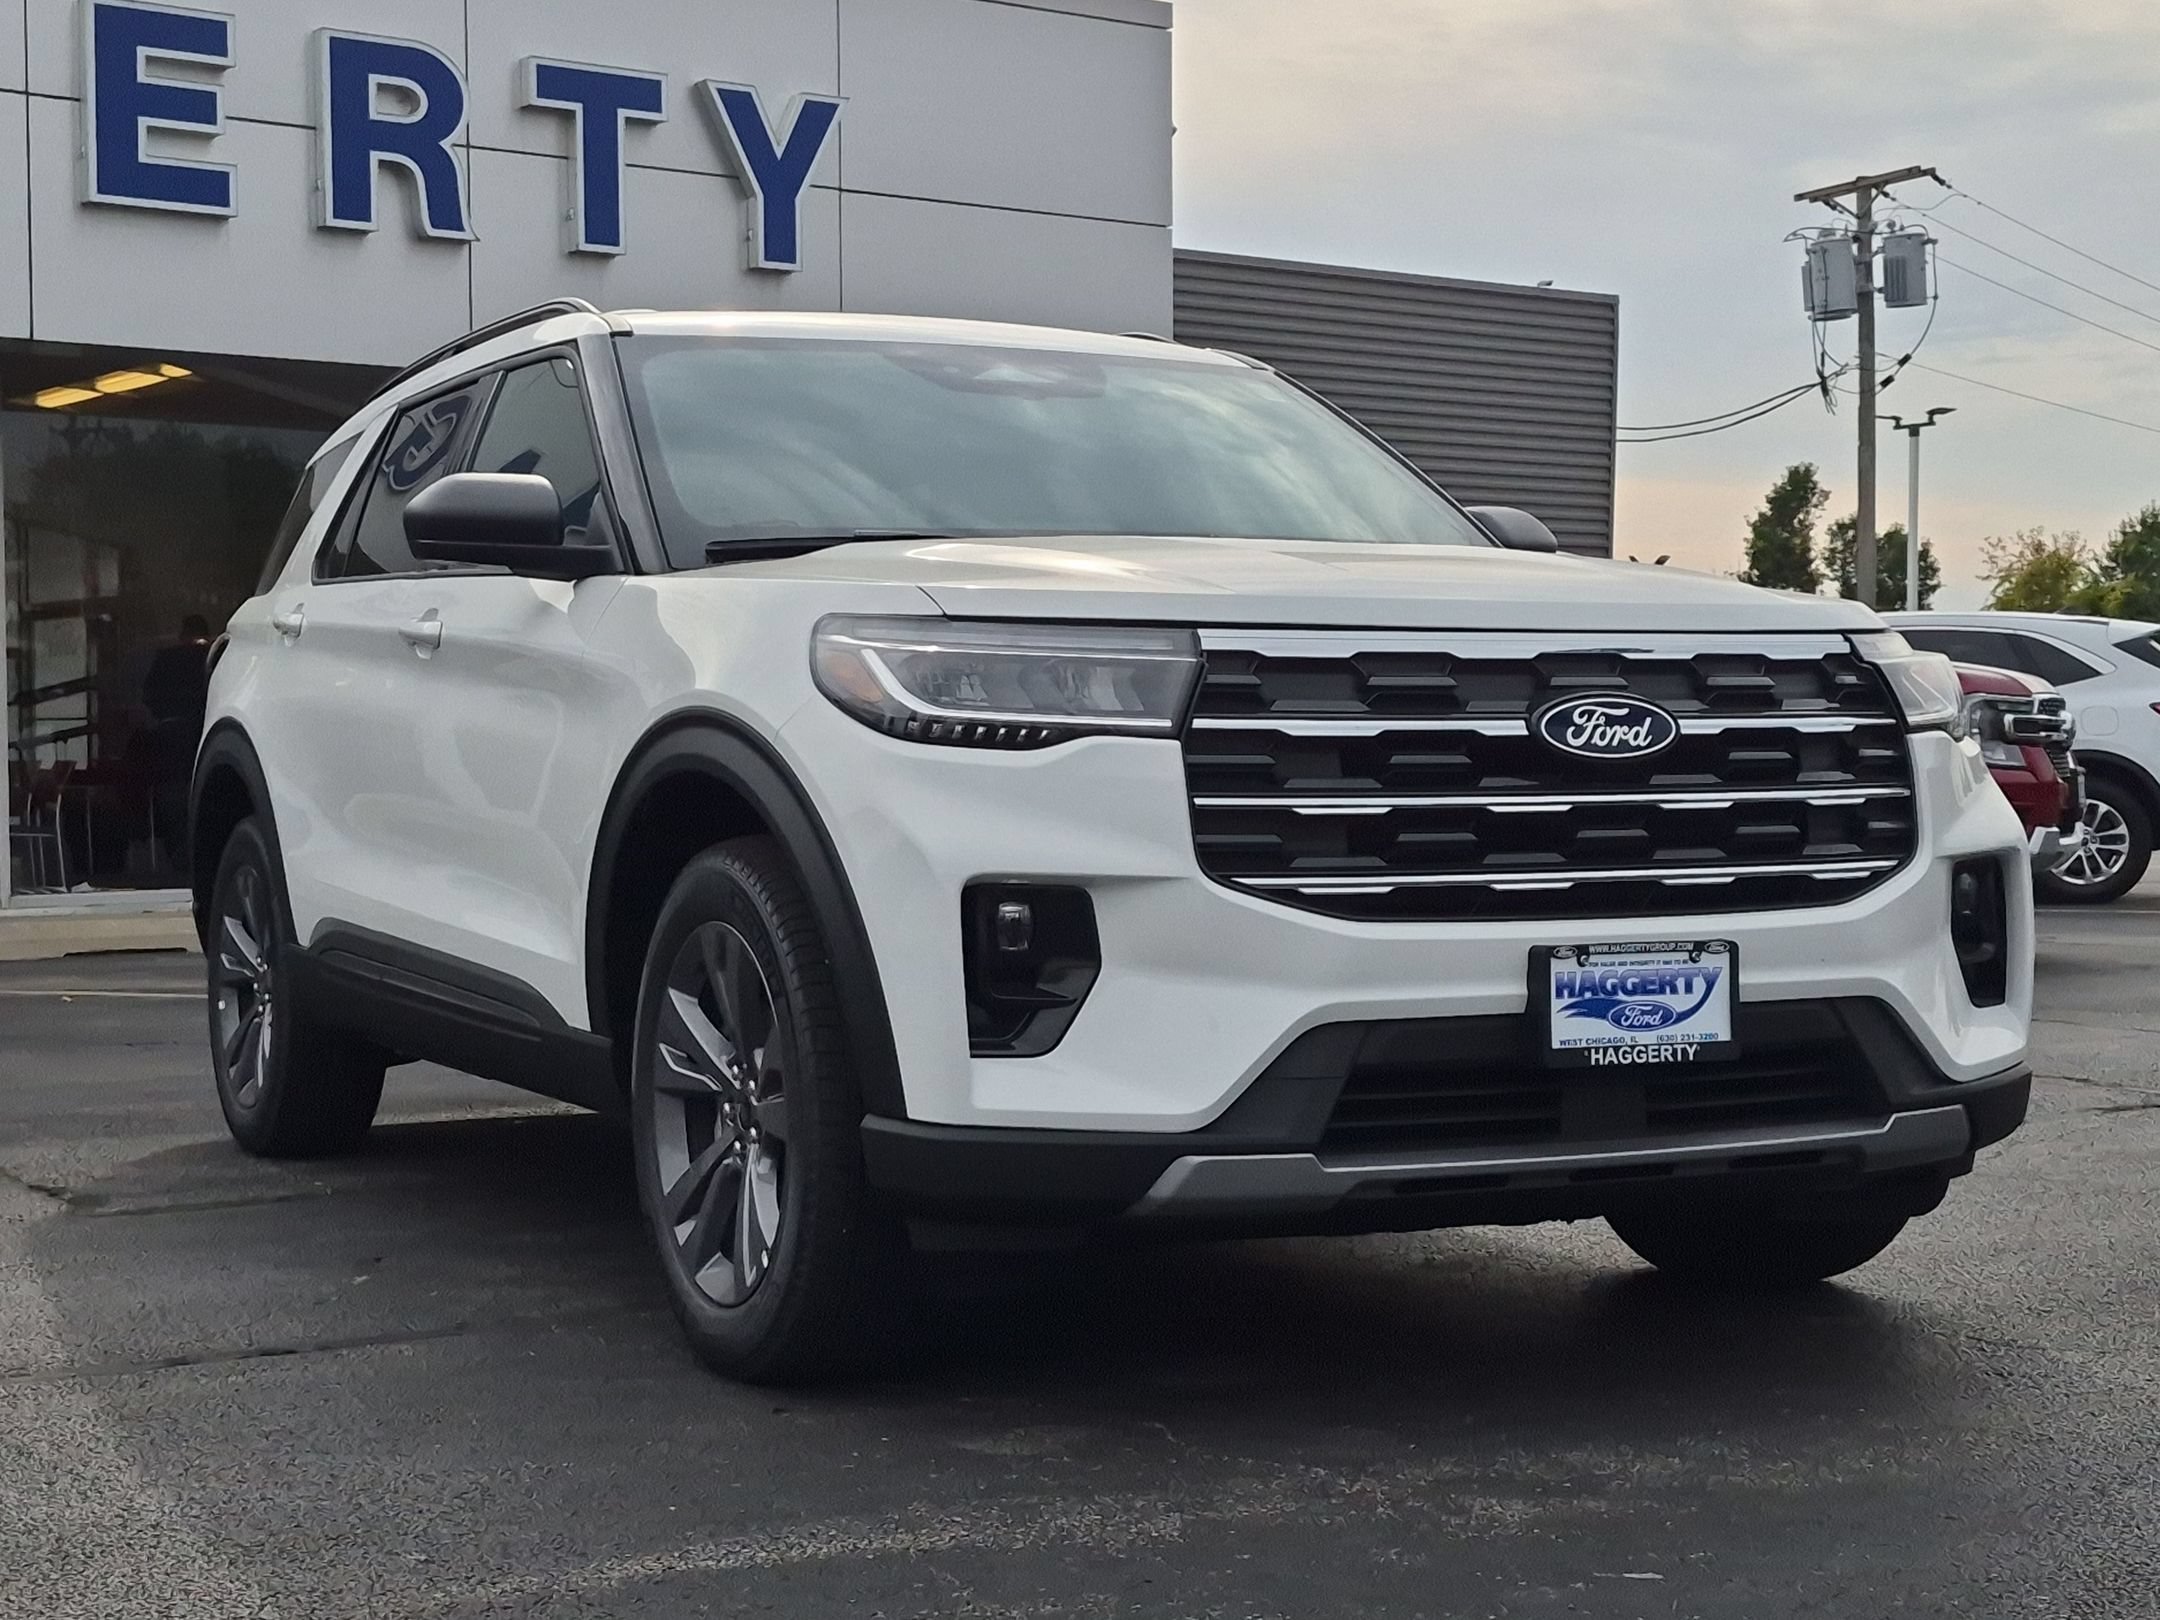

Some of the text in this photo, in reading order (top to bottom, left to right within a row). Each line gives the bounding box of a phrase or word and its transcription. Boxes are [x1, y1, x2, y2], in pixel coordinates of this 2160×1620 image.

[80, 0, 850, 274] ERTY
[1566, 705, 1653, 747] Ford
[1588, 942, 1694, 954] WWW.HAGGERTYGROUP.COM
[1555, 966, 1723, 999] HAGGERTY
[1621, 1005, 1663, 1027] Ford
[1559, 1038, 1583, 1046] WEST
[1656, 1033, 1678, 1043] (630)
[1590, 1043, 1698, 1066] HAGGERTY
